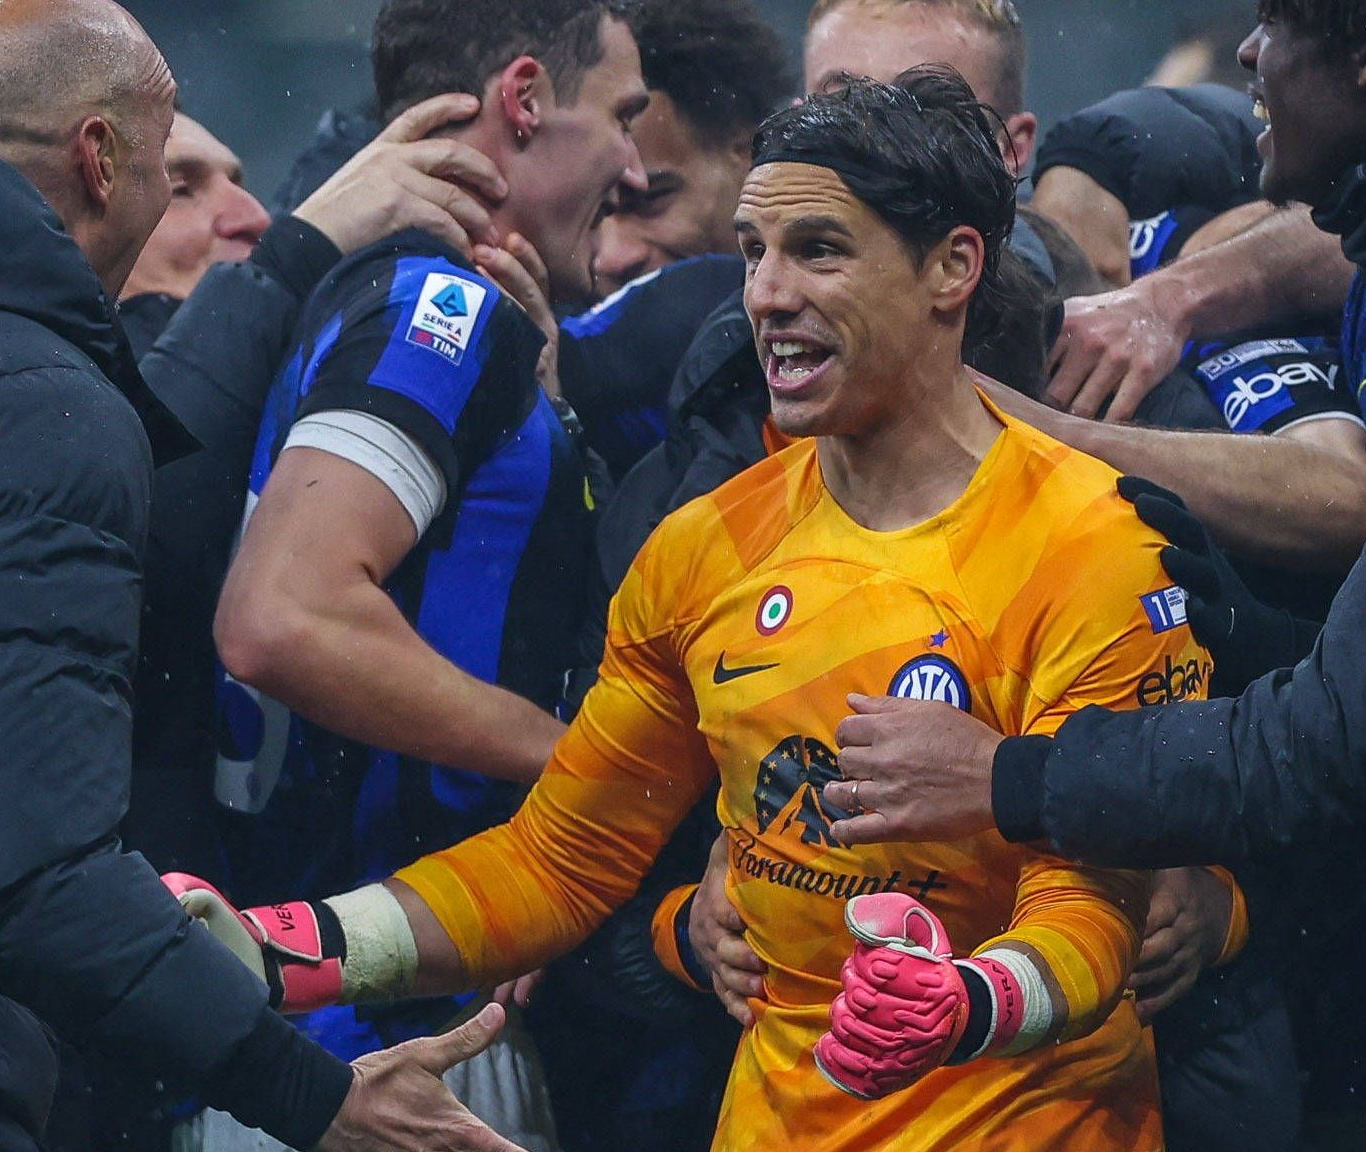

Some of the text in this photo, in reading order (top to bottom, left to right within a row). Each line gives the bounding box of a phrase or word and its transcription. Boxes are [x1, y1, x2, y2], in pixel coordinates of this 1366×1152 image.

[423, 313, 454, 330] SERIE
[432, 335, 457, 359] TIM
[1224, 361, 1339, 430] ebay
